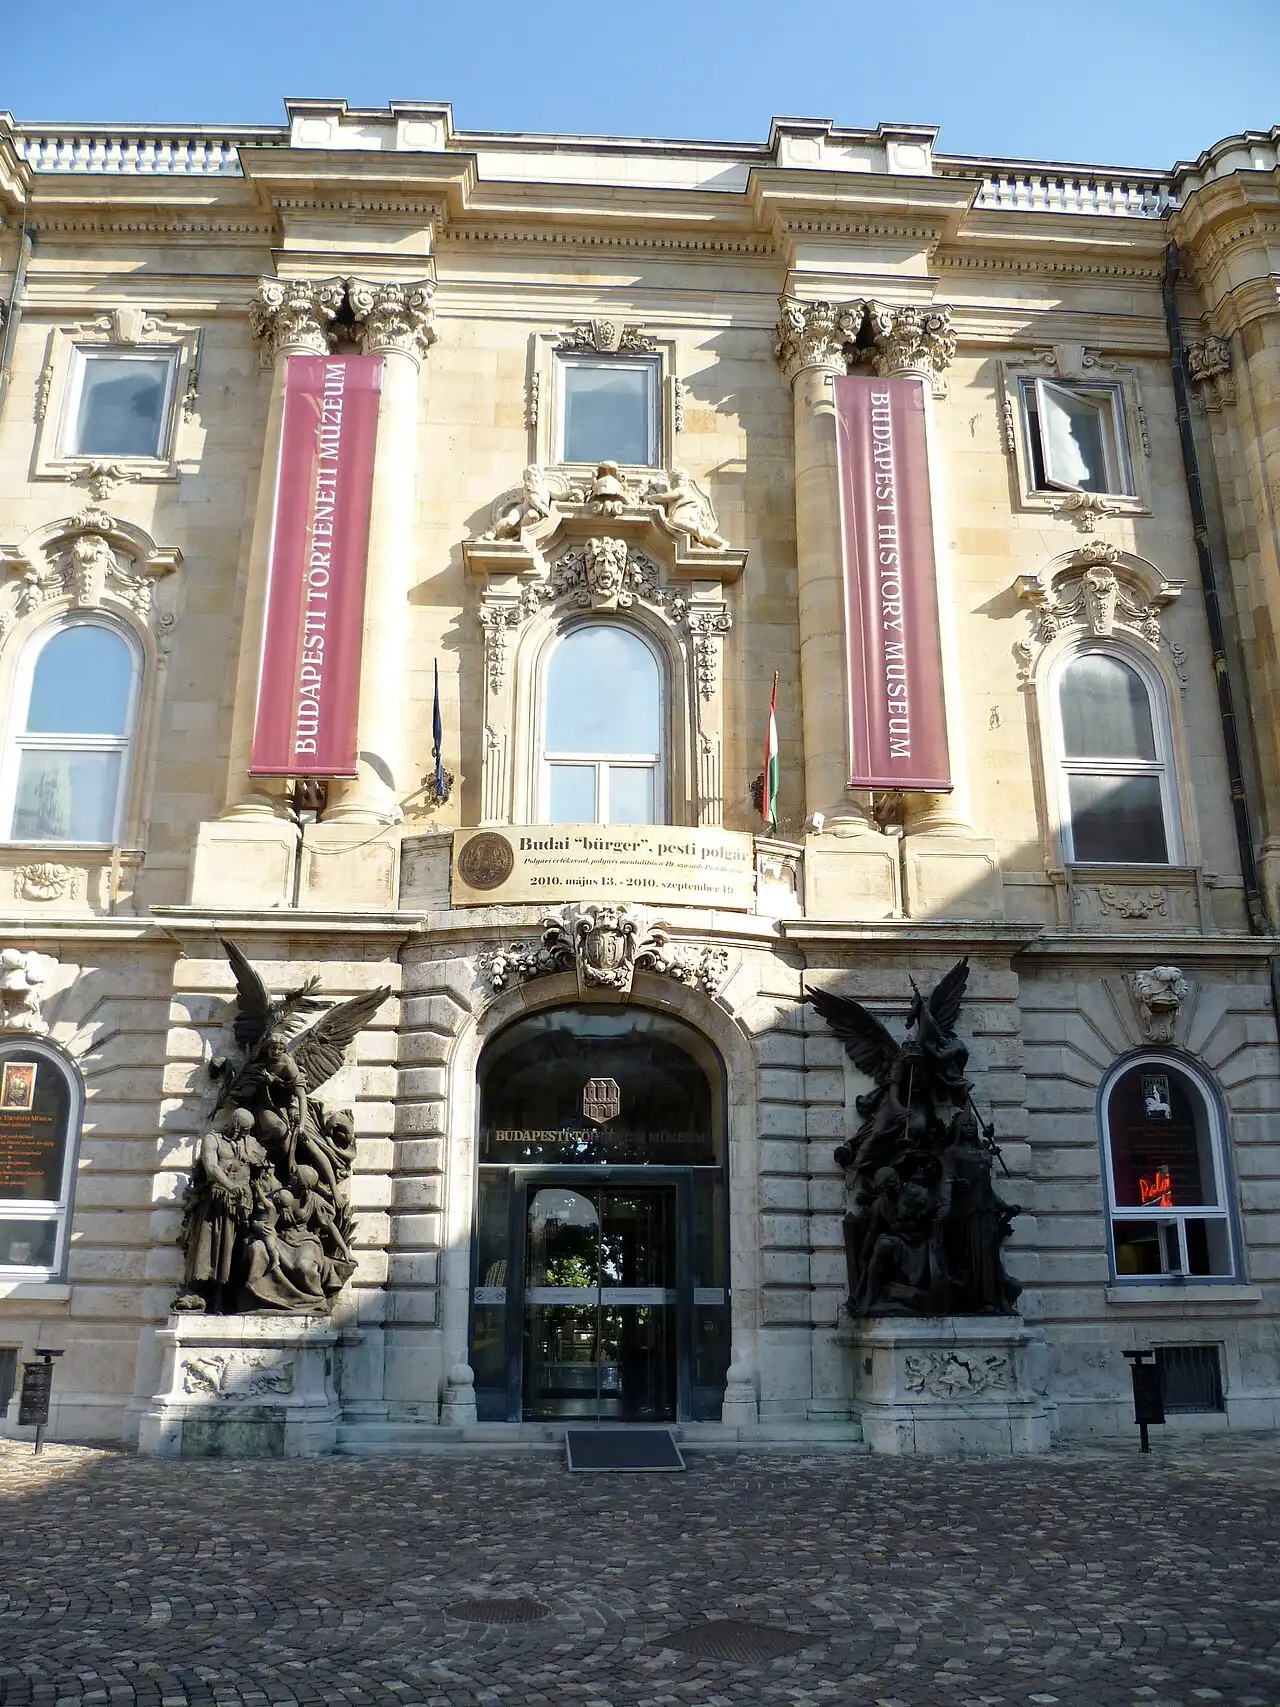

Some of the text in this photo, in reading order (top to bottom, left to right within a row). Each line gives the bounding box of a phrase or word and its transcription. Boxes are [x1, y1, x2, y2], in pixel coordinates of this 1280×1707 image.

[295, 363, 346, 755] BUDAPESTI TÖRTÉNETI MÚZEUM
[871, 391, 911, 759] BUDAPEST HISTORY MUSEUM
[519, 836, 570, 851] Budai
[657, 842, 696, 857] pesti
[701, 846, 749, 862] polgár
[530, 876, 563, 886] 2010.
[565, 876, 598, 888] május
[601, 876, 617, 887] 13.
[626, 877, 659, 888] 2010.
[661, 881, 720, 893] szeptember
[495, 1129, 570, 1142] BUDAPESTI
